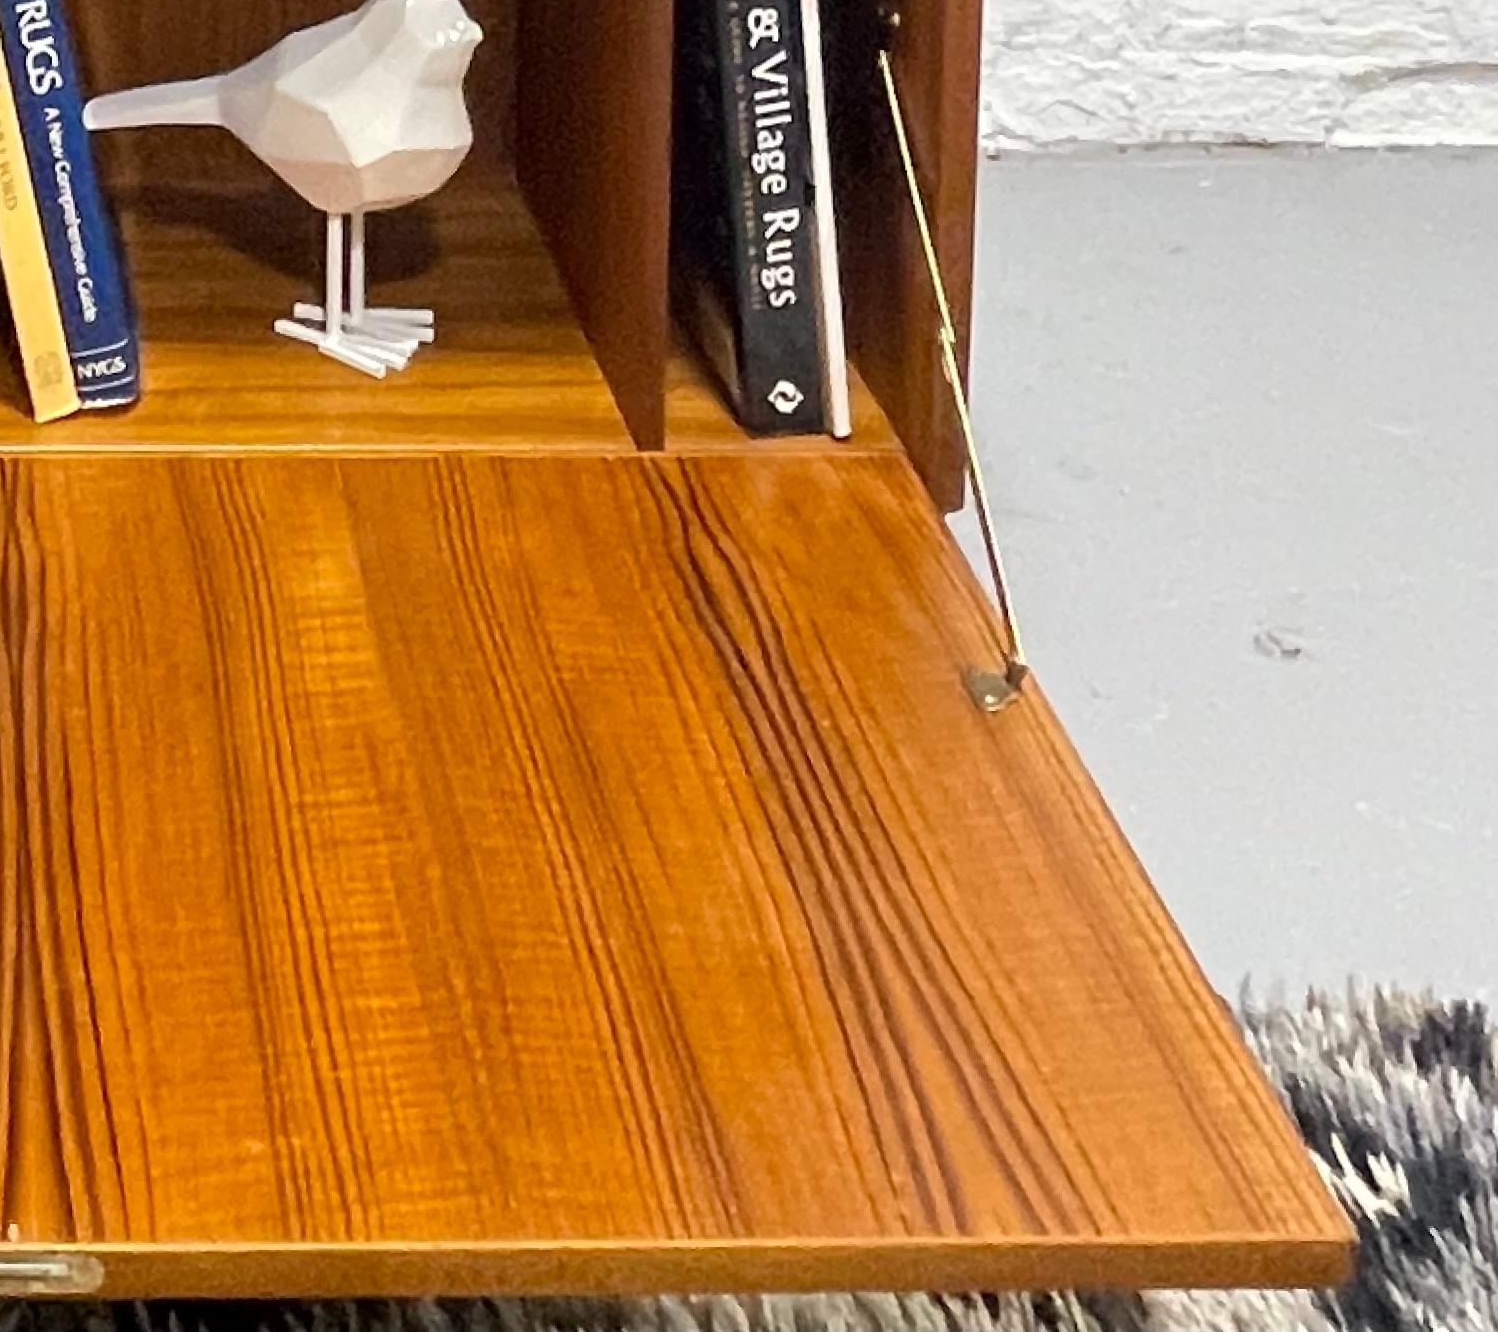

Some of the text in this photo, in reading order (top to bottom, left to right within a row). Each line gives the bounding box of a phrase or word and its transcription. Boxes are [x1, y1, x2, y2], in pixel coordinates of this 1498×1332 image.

[746, 7, 781, 51] &
[43, 106, 63, 121] A
[750, 49, 794, 195] Village
[47, 122, 65, 159] New
[760, 206, 801, 310] Rugs
[76, 356, 127, 380] NYGS
